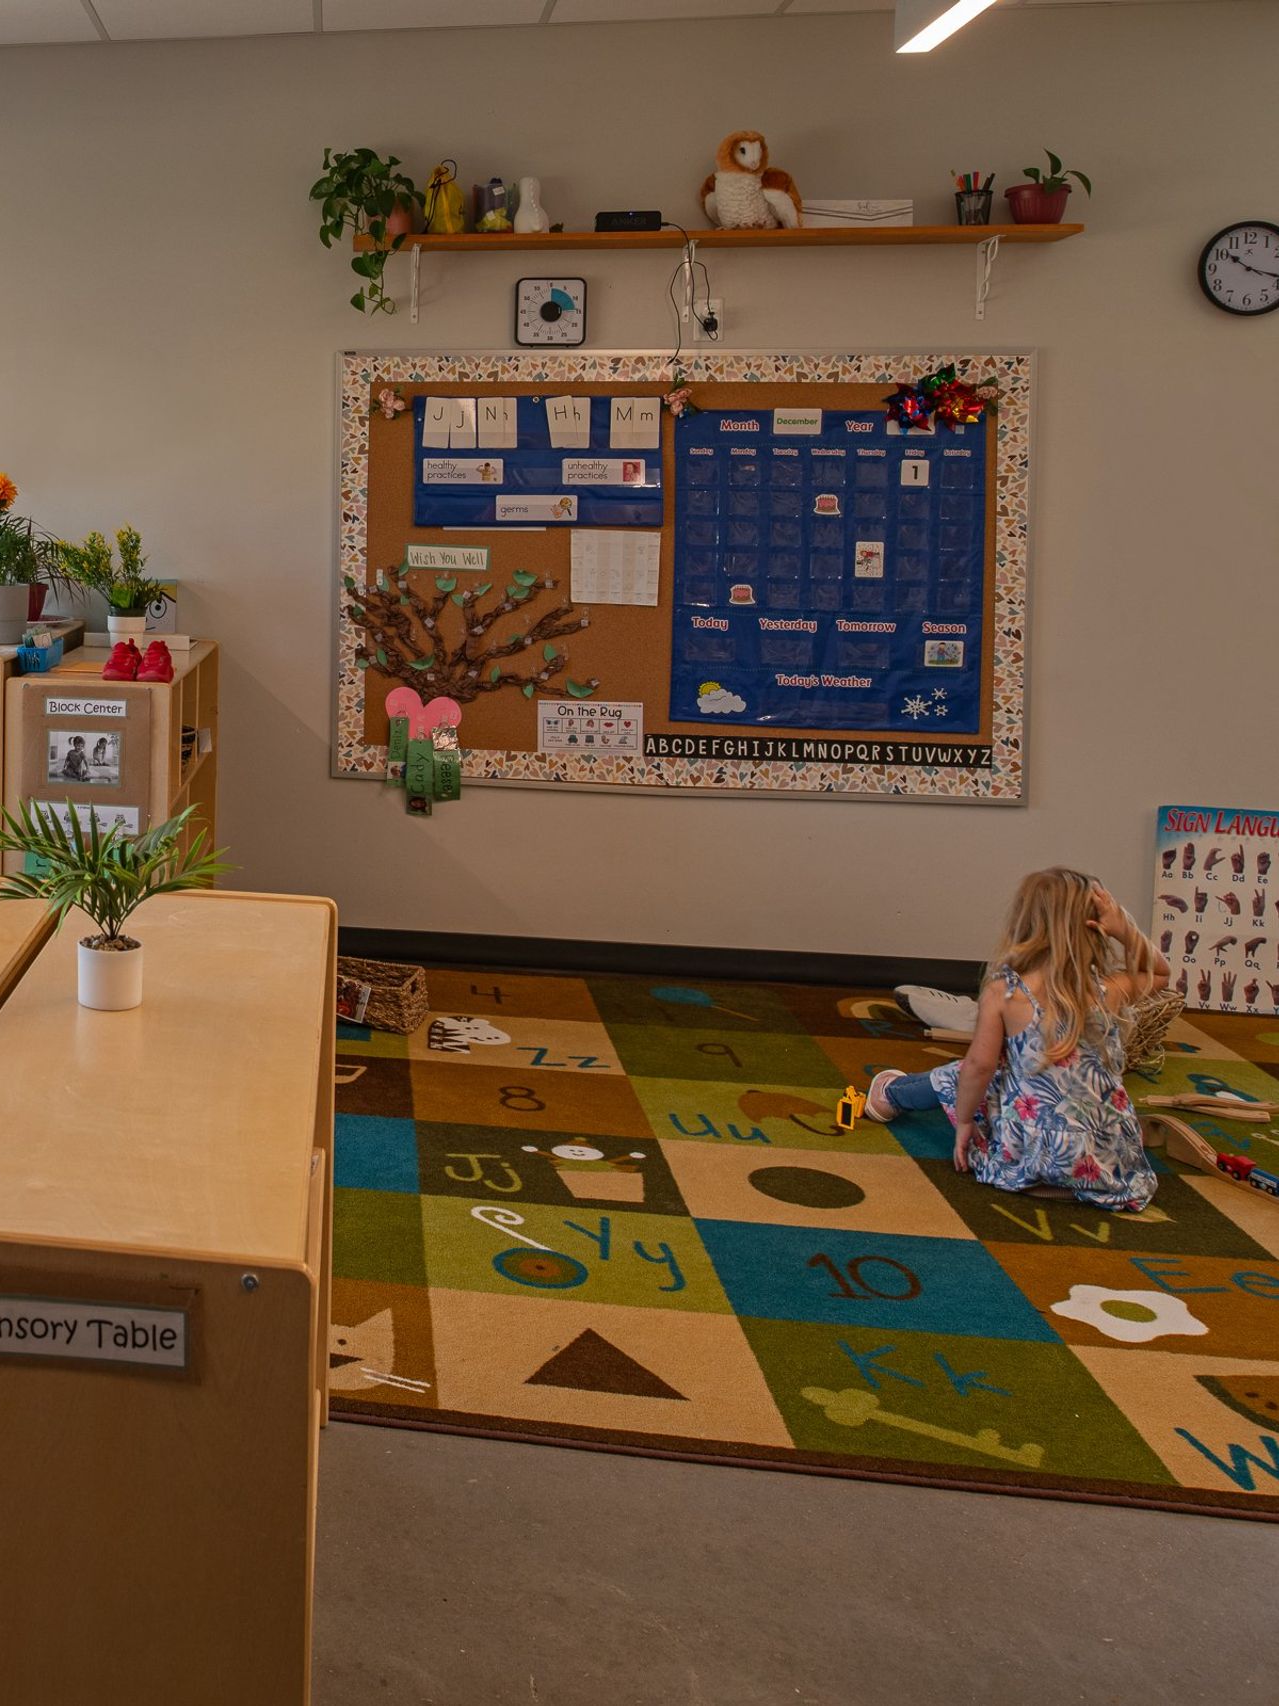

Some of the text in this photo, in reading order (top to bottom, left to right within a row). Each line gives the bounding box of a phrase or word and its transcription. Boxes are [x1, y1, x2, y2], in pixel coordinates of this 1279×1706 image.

[1228, 236, 1239, 249] 11
[1244, 232, 1257, 244] 12
[1264, 235, 1270, 248] 1
[1215, 248, 1229, 261] 10
[1208, 263, 1217, 276] 9
[1213, 279, 1222, 291] 8
[1226, 290, 1234, 302] 7
[1242, 293, 1251, 306] 6
[1259, 289, 1269, 302] 5
[433, 406, 465, 429] J j
[485, 407, 497, 421] N
[553, 406, 568, 421] H
[616, 406, 653, 421] M m
[719, 420, 760, 432] Month
[776, 416, 818, 427] December
[845, 420, 874, 433] Year
[690, 447, 971, 458] Sunday Monday Tuesday Wednesday Thursday Friday Saturday
[427, 459, 457, 472] healthy
[567, 459, 608, 473] unhealthy
[912, 465, 918, 480] 1
[427, 469, 467, 480] practices
[567, 469, 608, 480] practices
[500, 504, 529, 517] germs
[410, 552, 484, 566] Wish You Well
[691, 616, 728, 631] Today
[758, 618, 817, 633] Yesterday
[837, 620, 897, 633] Tomorrow
[922, 622, 966, 634] Season
[776, 674, 872, 689] Today's Weather
[49, 701, 123, 714] Block Center
[557, 705, 622, 719] On the Rug
[1164, 808, 1211, 833] SIGN
[1161, 870, 1269, 884] Aa Bb Cc Dd Ee
[1163, 913, 1265, 928] Hh Ii Jj Kk
[1182, 955, 1197, 964] Oo
[1214, 957, 1226, 967] Pp
[1244, 959, 1261, 970] Qq
[471, 983, 510, 1004] 4
[696, 1042, 742, 1068] 9
[498, 1086, 546, 1112] 8
[444, 1152, 523, 1193] Jj
[807, 1251, 923, 1301] 10
[86, 1319, 177, 1351] Table
